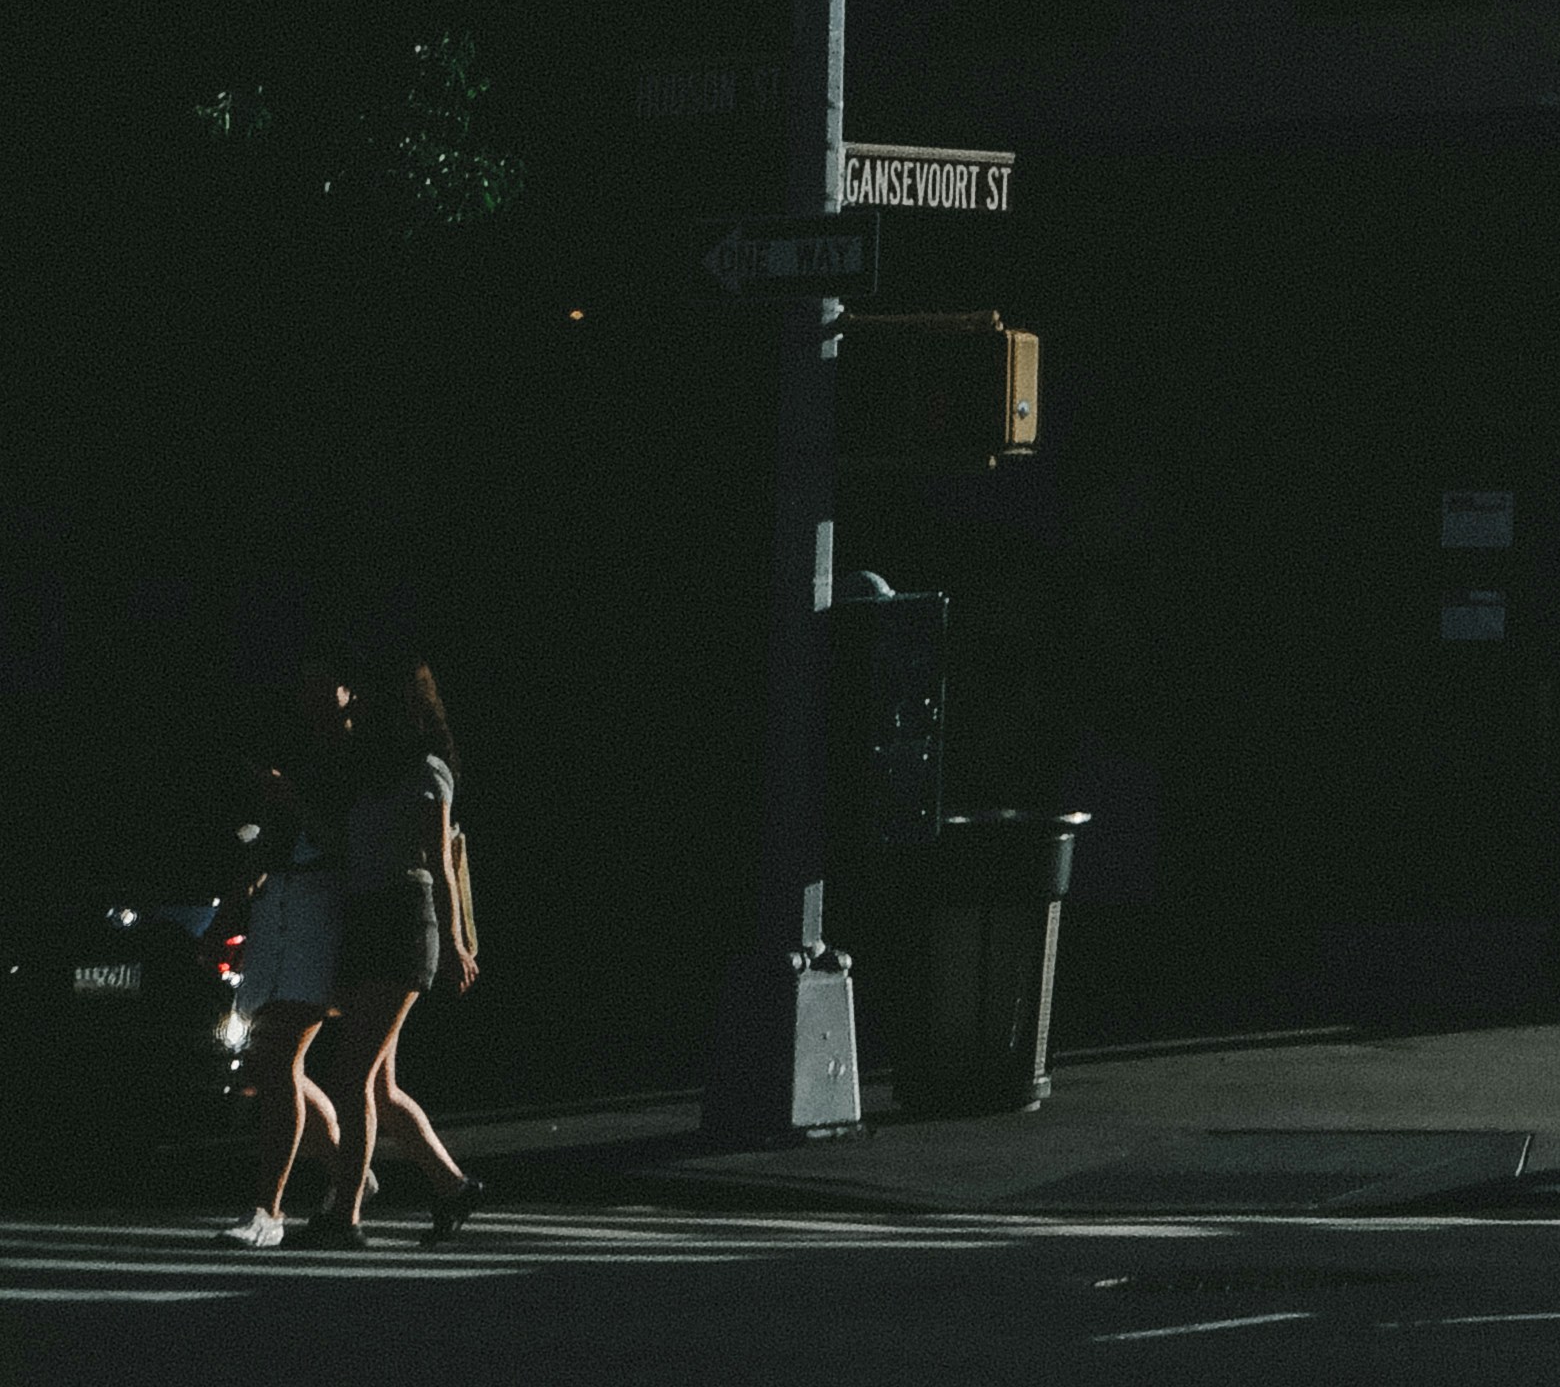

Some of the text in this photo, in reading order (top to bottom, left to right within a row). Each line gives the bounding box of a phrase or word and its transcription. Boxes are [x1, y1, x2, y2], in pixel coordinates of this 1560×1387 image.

[846, 158, 1012, 211] GANSEVOORT ST
[718, 236, 853, 275] ONE WAY
